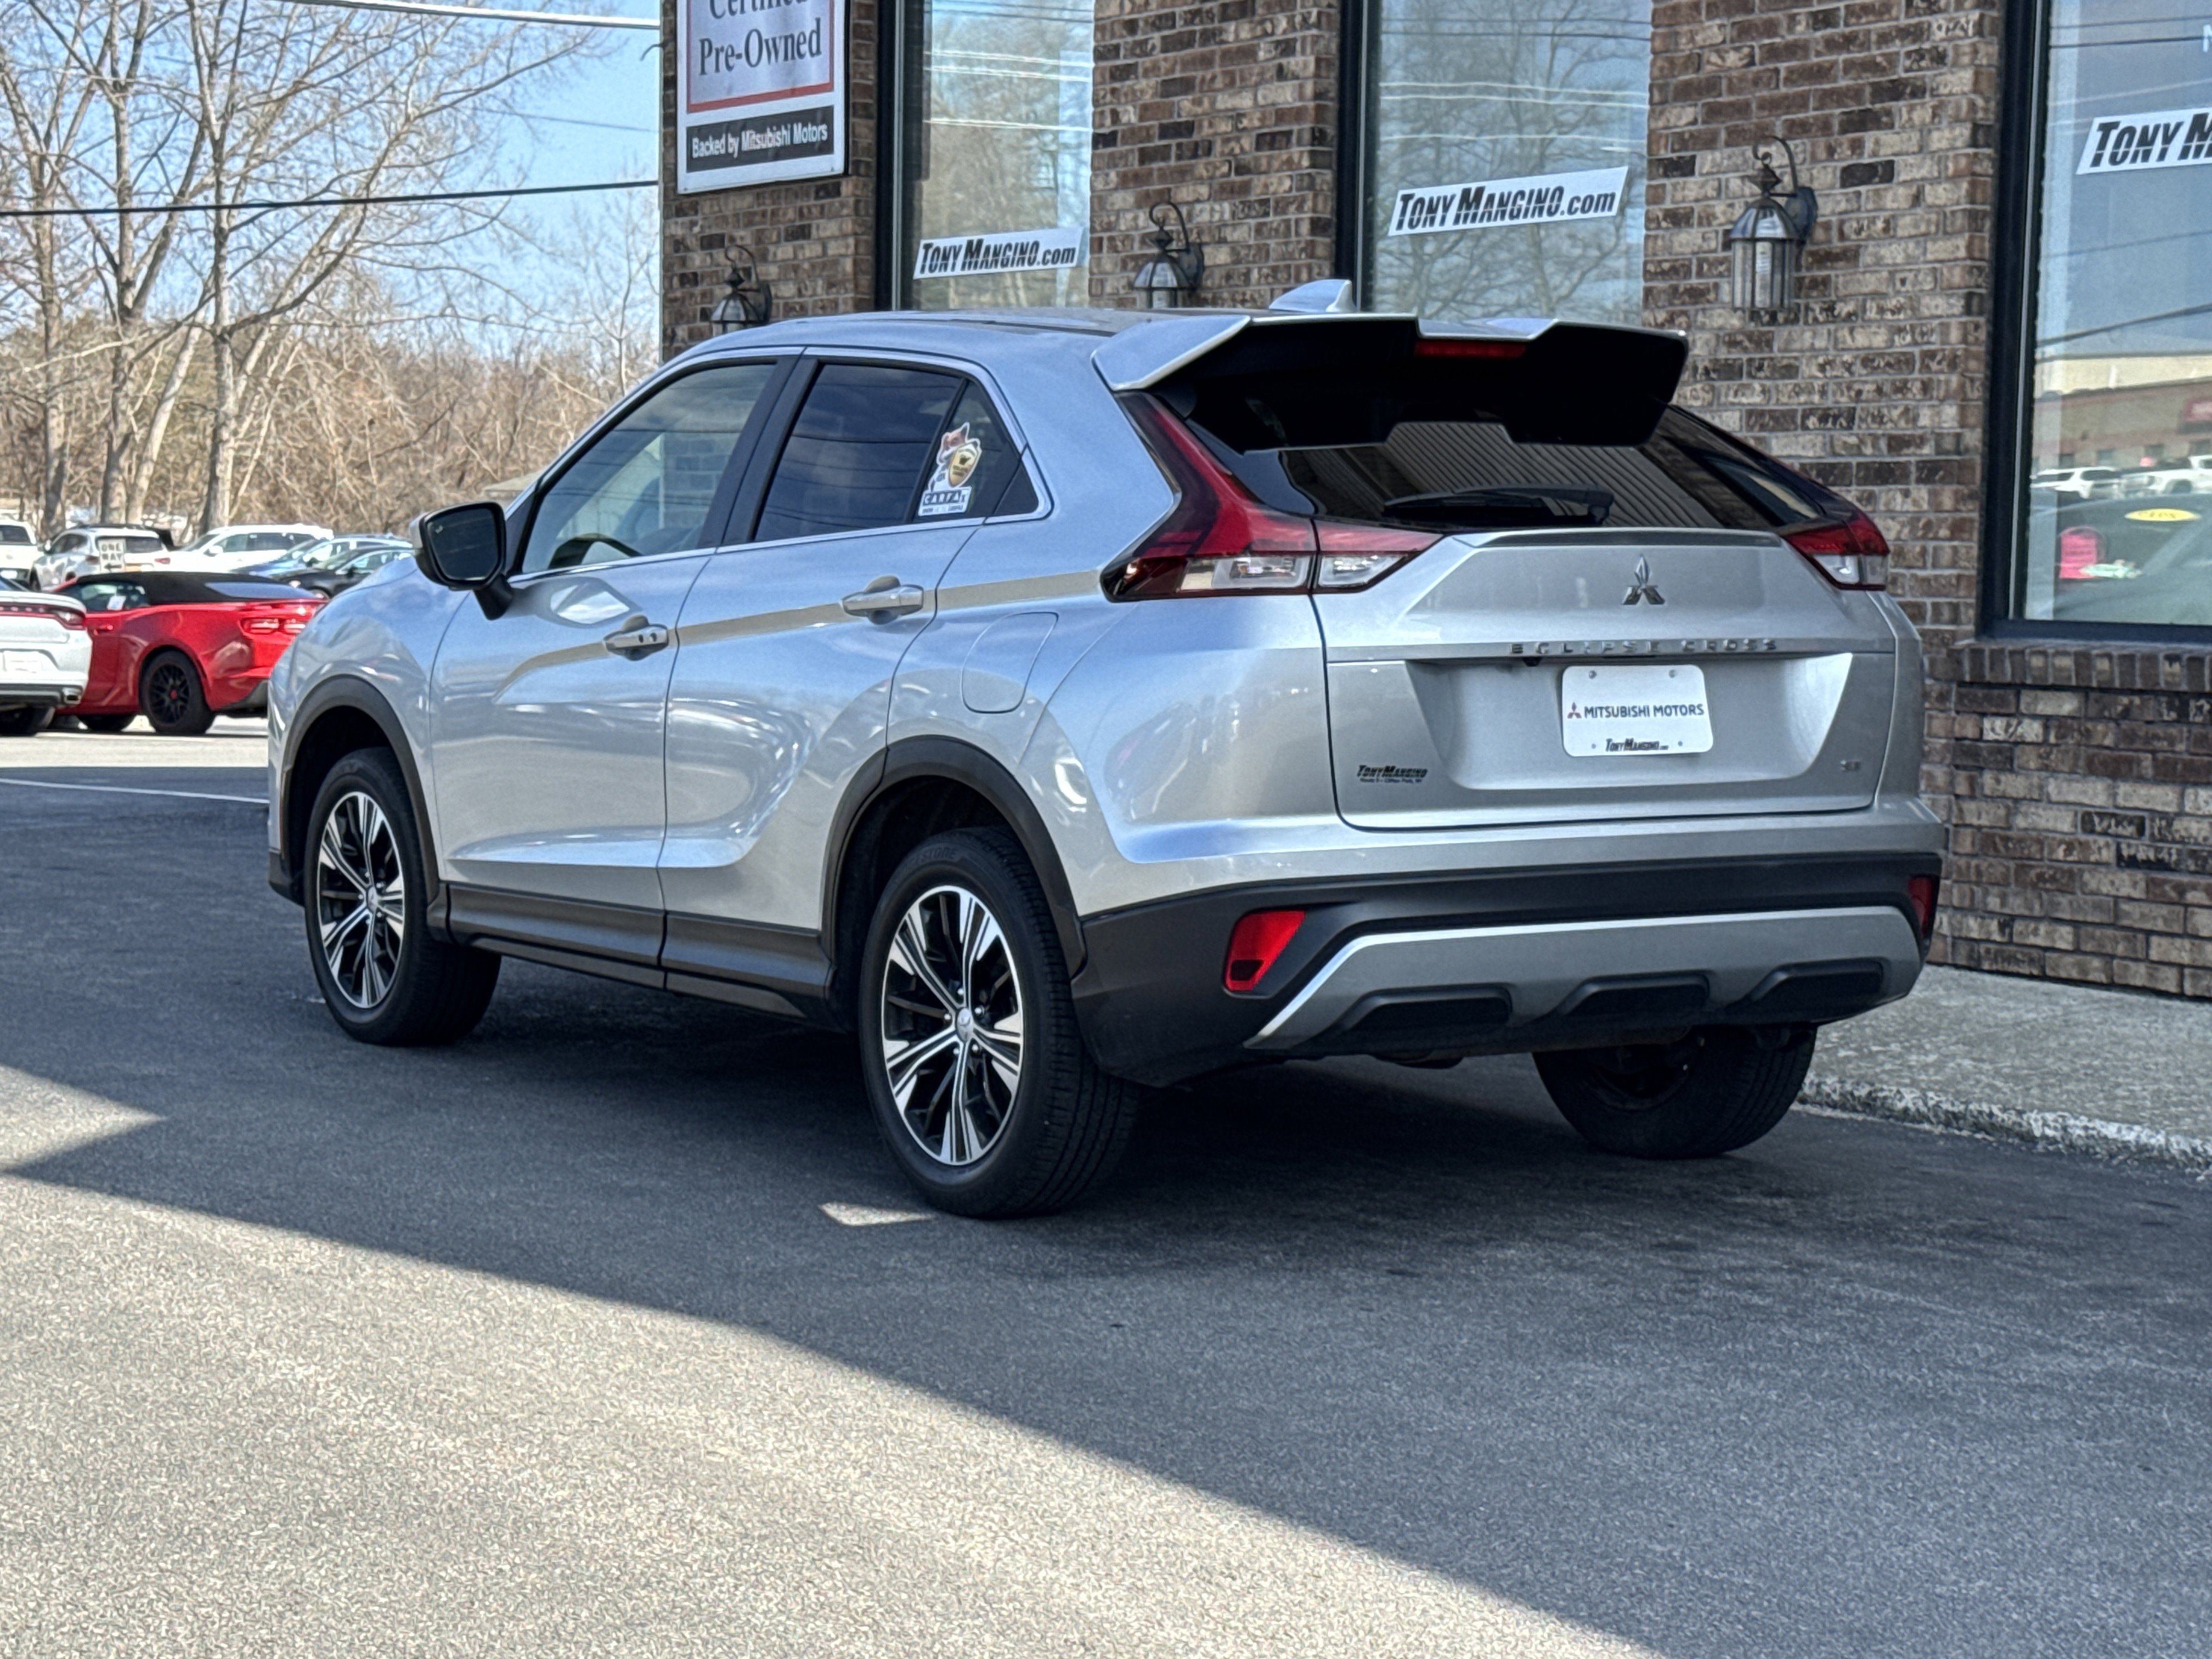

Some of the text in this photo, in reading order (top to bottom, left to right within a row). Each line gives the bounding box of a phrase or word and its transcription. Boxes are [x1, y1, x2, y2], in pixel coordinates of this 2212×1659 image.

[698, 17, 822, 75] Pre-Owned
[692, 120, 828, 159] Backed by Mitsubishi Motors
[1510, 641, 1661, 654] ECLIPSE
[1584, 704, 1705, 719] MITSUBISHI MOTORS
